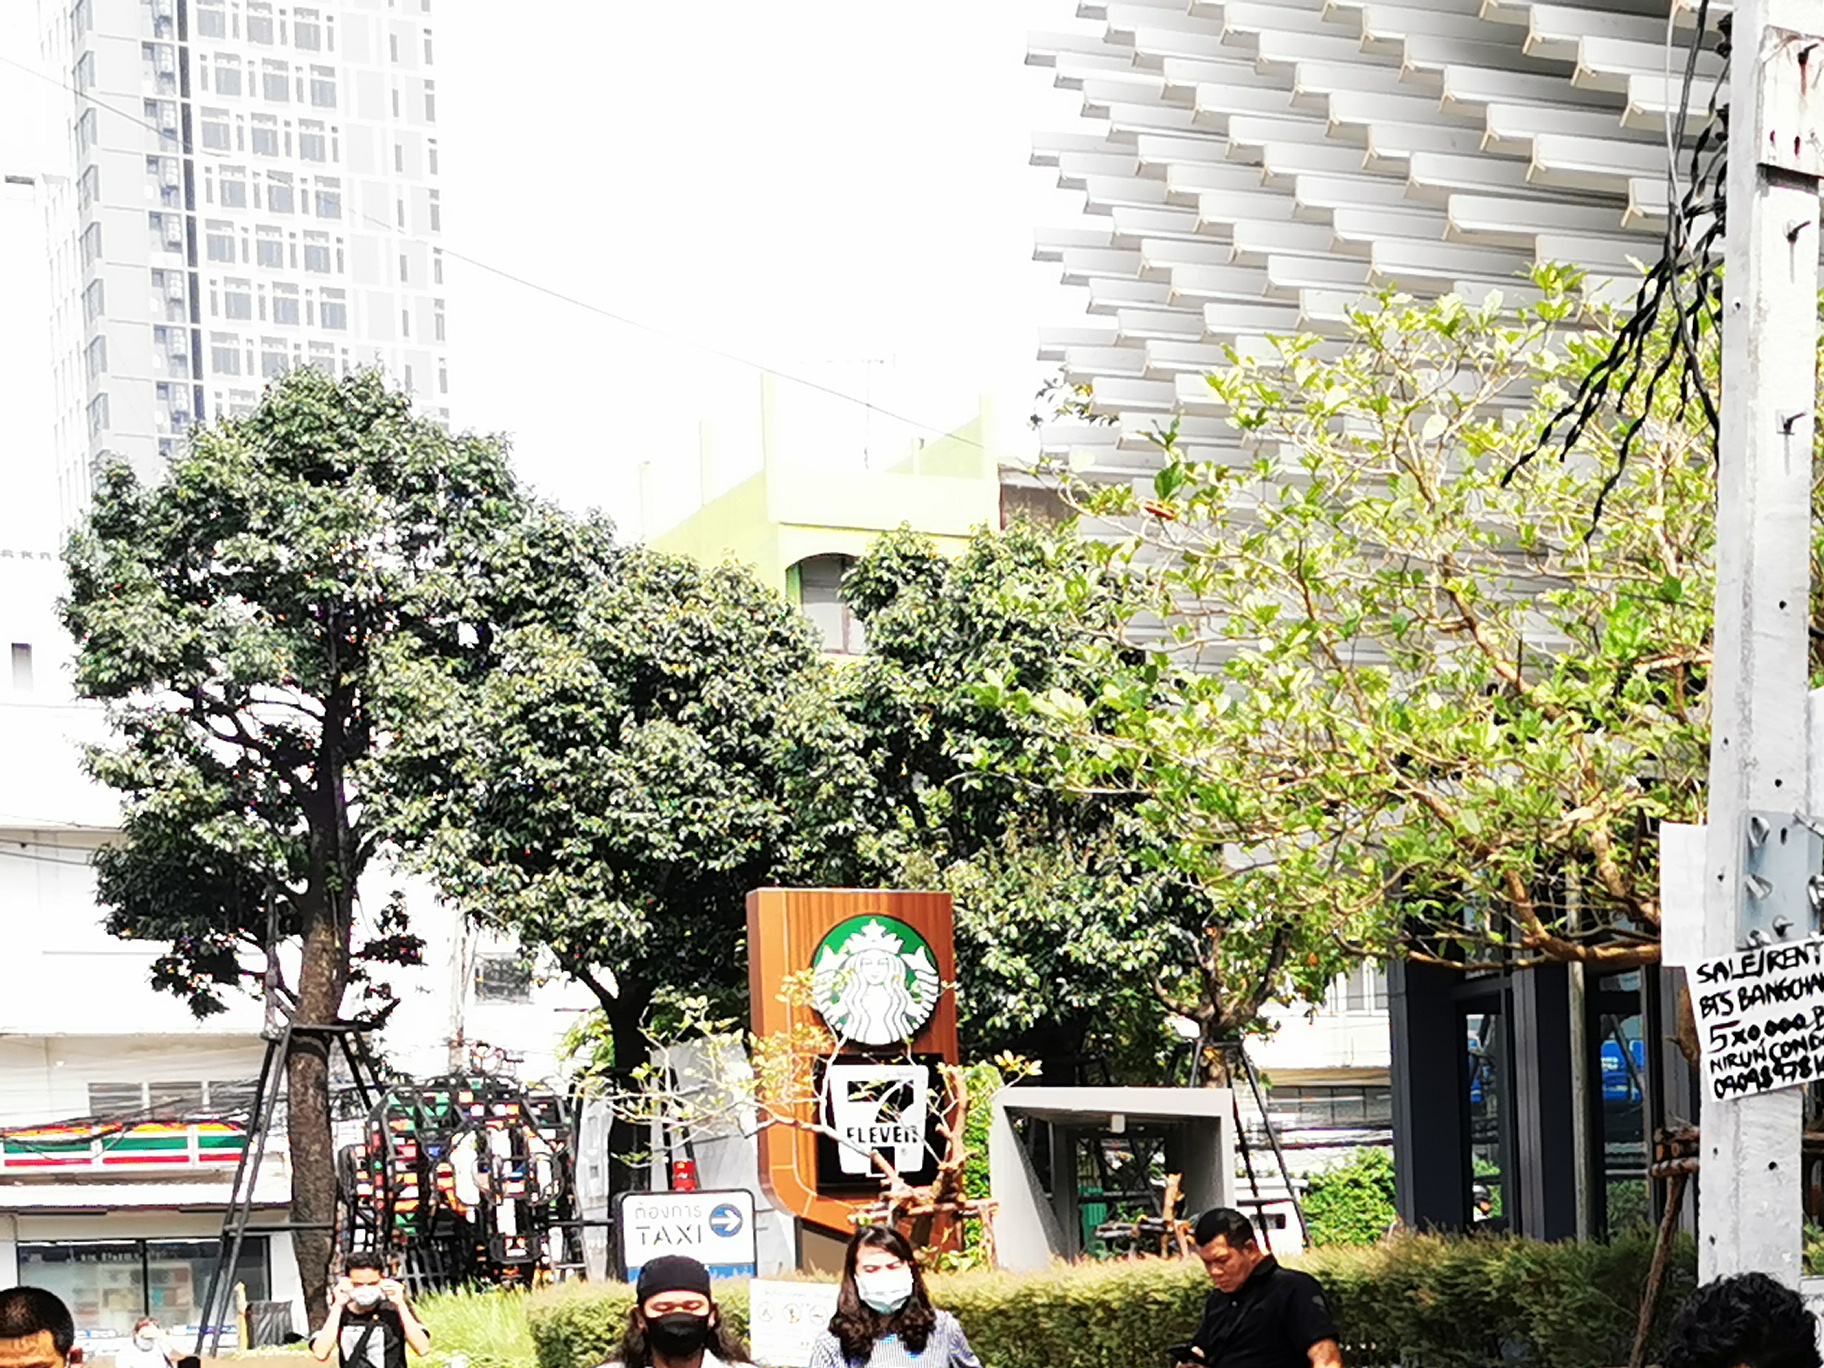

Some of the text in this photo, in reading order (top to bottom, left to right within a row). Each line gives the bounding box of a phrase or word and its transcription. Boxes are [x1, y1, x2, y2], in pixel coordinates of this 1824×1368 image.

[1699, 988, 1734, 1019] BTS
[634, 1201, 702, 1220] ต้องการ
[635, 1223, 702, 1246] TAXI
